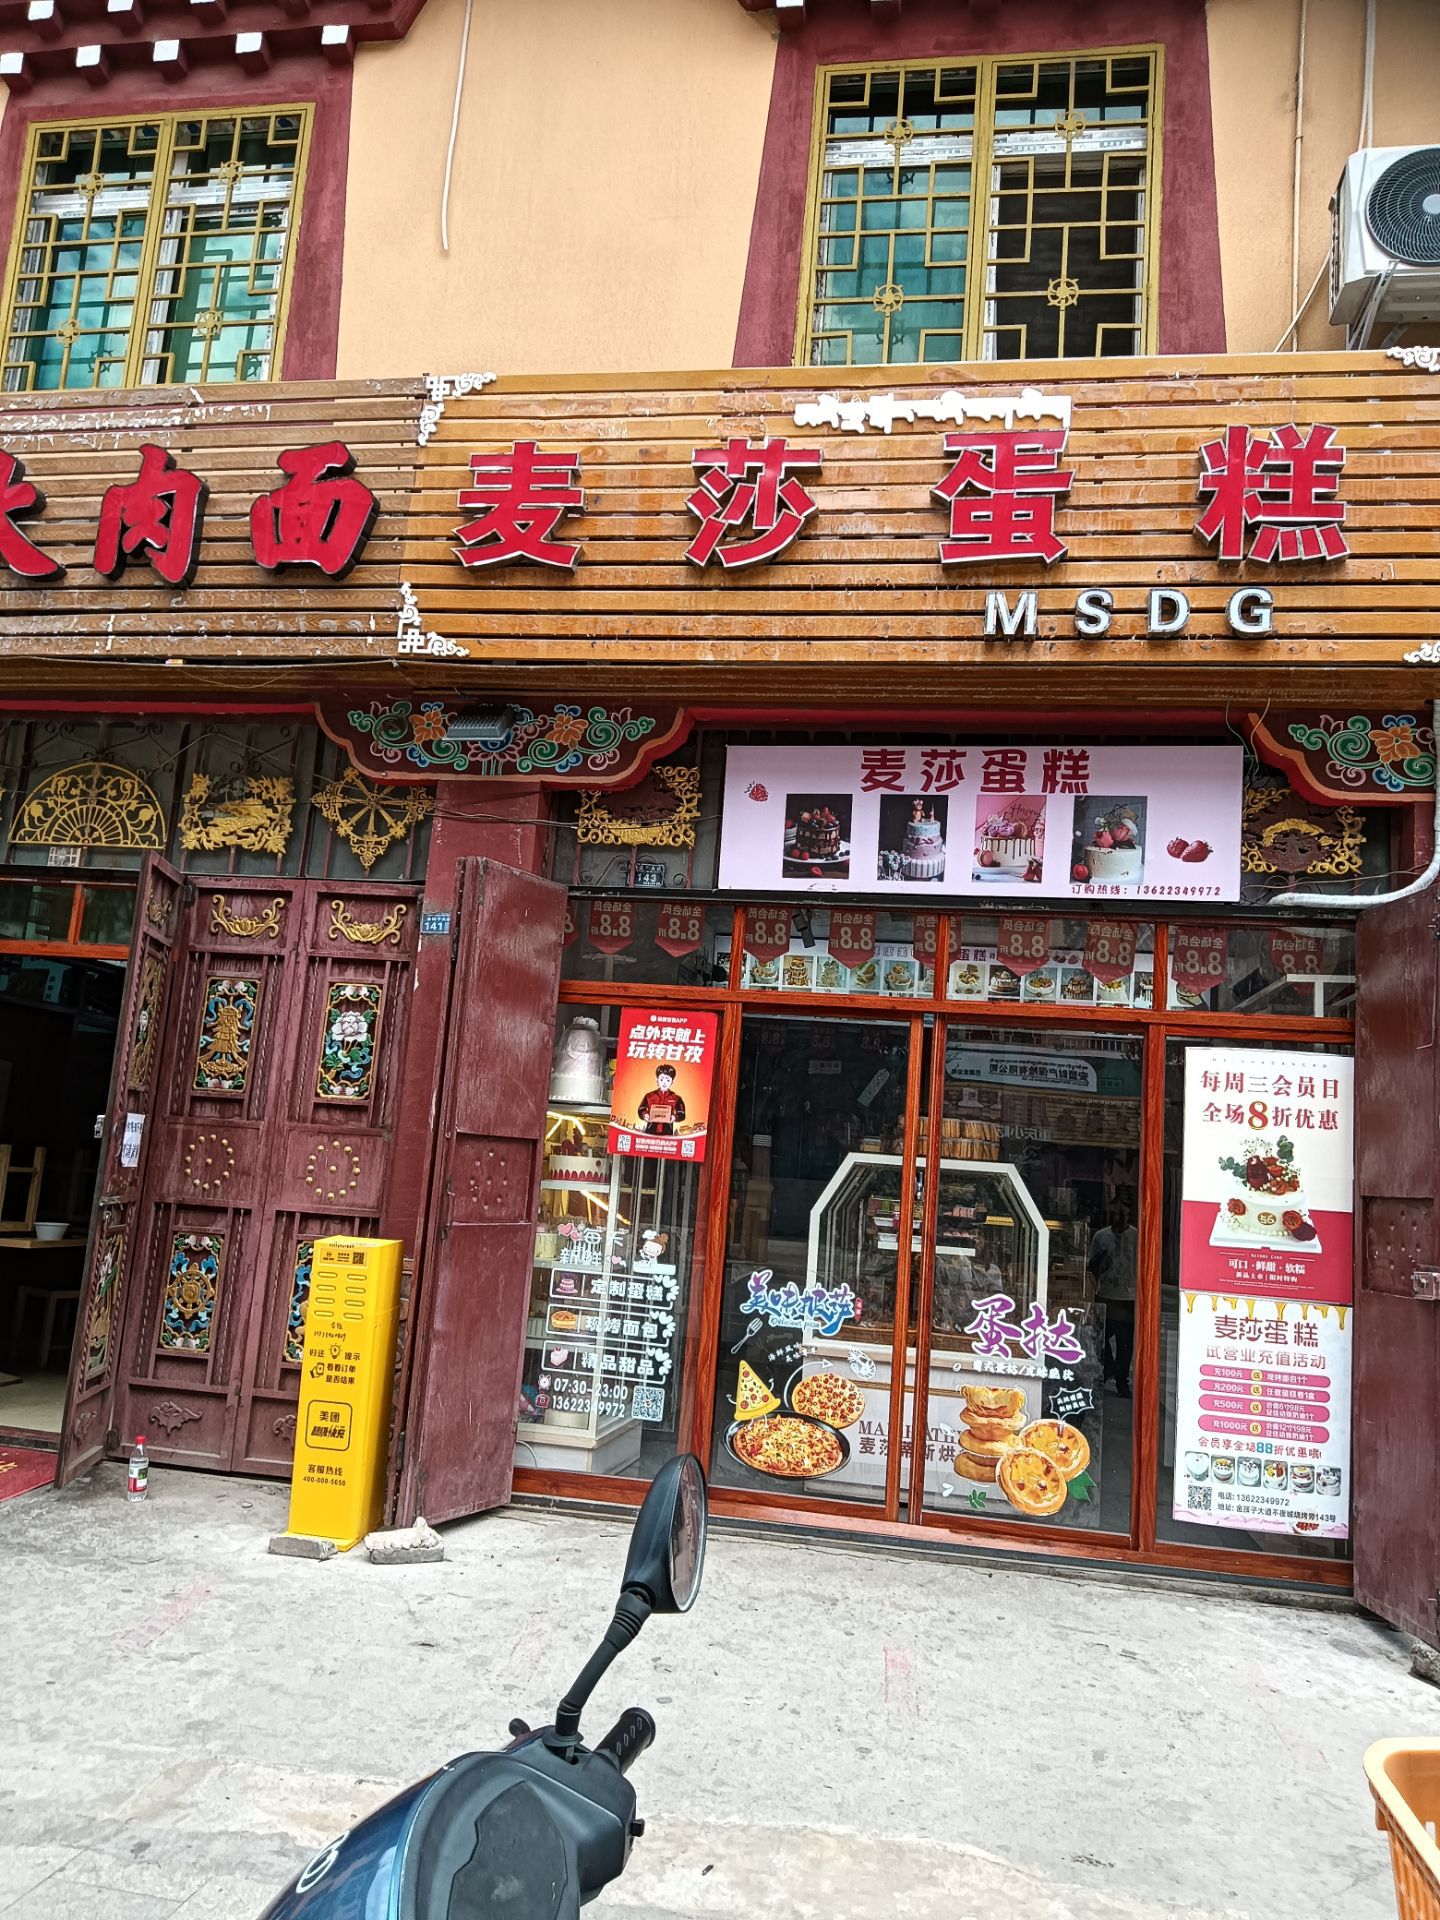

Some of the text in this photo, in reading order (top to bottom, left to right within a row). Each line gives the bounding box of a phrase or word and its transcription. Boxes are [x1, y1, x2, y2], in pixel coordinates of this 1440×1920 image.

[452, 424, 1348, 570] 麦莎蛋糕
[984, 586, 1275, 641] MSDG
[860, 748, 1090, 795] 麦莎蛋糕
[638, 873, 657, 882] 143
[424, 921, 443, 931] 141
[629, 1024, 706, 1044] 点外卖就上
[627, 1041, 704, 1063] 玩转甘孜
[1200, 1070, 1340, 1100] 每周三会员日
[1202, 1100, 1340, 1130] 全场8折优惠
[559, 1247, 602, 1267] 新鲜
[590, 1279, 664, 1302] 定制蛋糕
[585, 1315, 659, 1340] 现烤面包
[965, 1293, 1086, 1365] 蛋挞
[1214, 1314, 1319, 1348] 麦莎蛋糕
[310, 1348, 361, 1361] 归还 提示
[581, 1352, 655, 1376] 精品甜品
[1206, 1346, 1327, 1370] 试营业充值活动
[327, 1363, 356, 1373] 看看订单
[1213, 1367, 1243, 1379] 充100元
[1253, 1371, 1261, 1381] 送
[325, 1375, 355, 1385] 是否结束
[1213, 1381, 1244, 1394] 充200元
[1252, 1386, 1261, 1396] 送
[1212, 1399, 1244, 1411] 充500元
[1252, 1403, 1260, 1413] 送
[319, 1410, 340, 1423] 美团
[1212, 1420, 1248, 1432] 充1000元
[1251, 1424, 1260, 1434] 送
[307, 1464, 343, 1477] 客服热线
